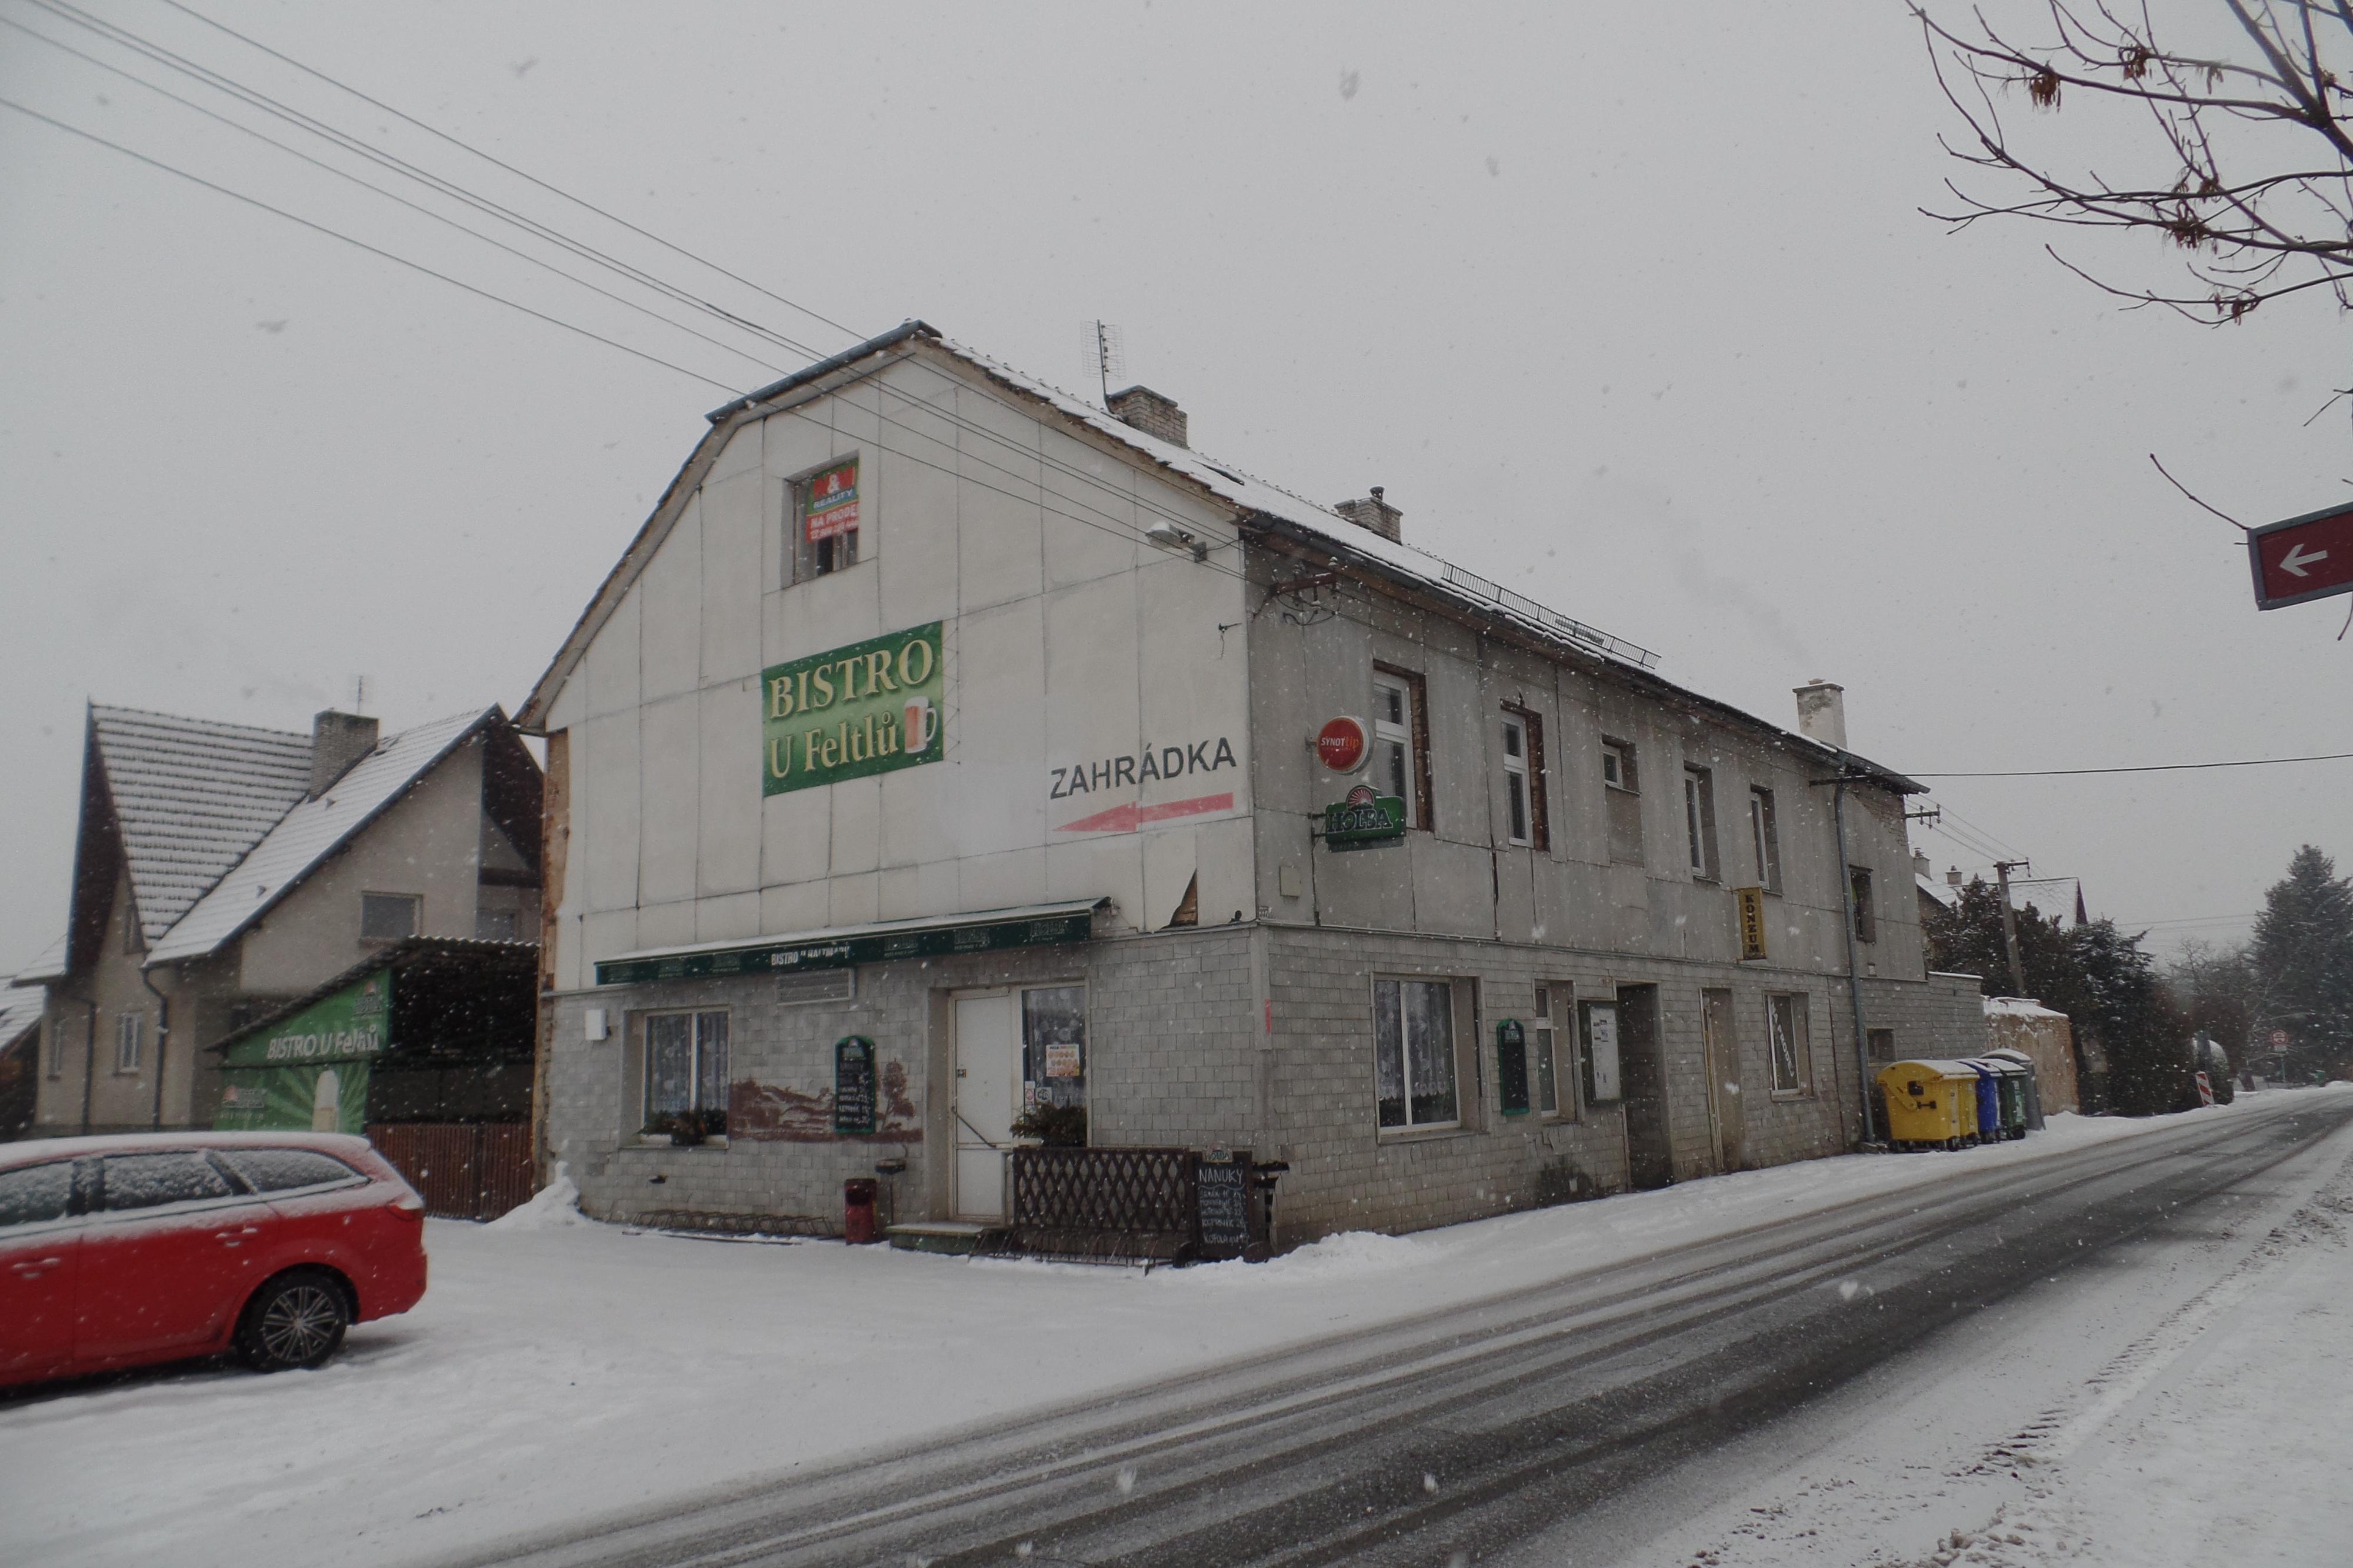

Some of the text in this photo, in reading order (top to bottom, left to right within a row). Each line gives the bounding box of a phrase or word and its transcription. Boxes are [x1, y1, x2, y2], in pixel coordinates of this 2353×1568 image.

[813, 488, 852, 509] REALITY
[810, 504, 859, 529] NA PRODE
[768, 639, 933, 720] BISTRO
[771, 710, 899, 778] U Feltlů
[1321, 736, 1346, 746] SYNOT
[1050, 737, 1237, 799] ZAHRÁDKA
[1327, 808, 1393, 833] HOLBA
[1745, 895, 1759, 952] KONZUM
[771, 952, 799, 966] BISTRO
[267, 1034, 316, 1059] BISTRO
[1199, 1167, 1243, 1185] NANUKY
